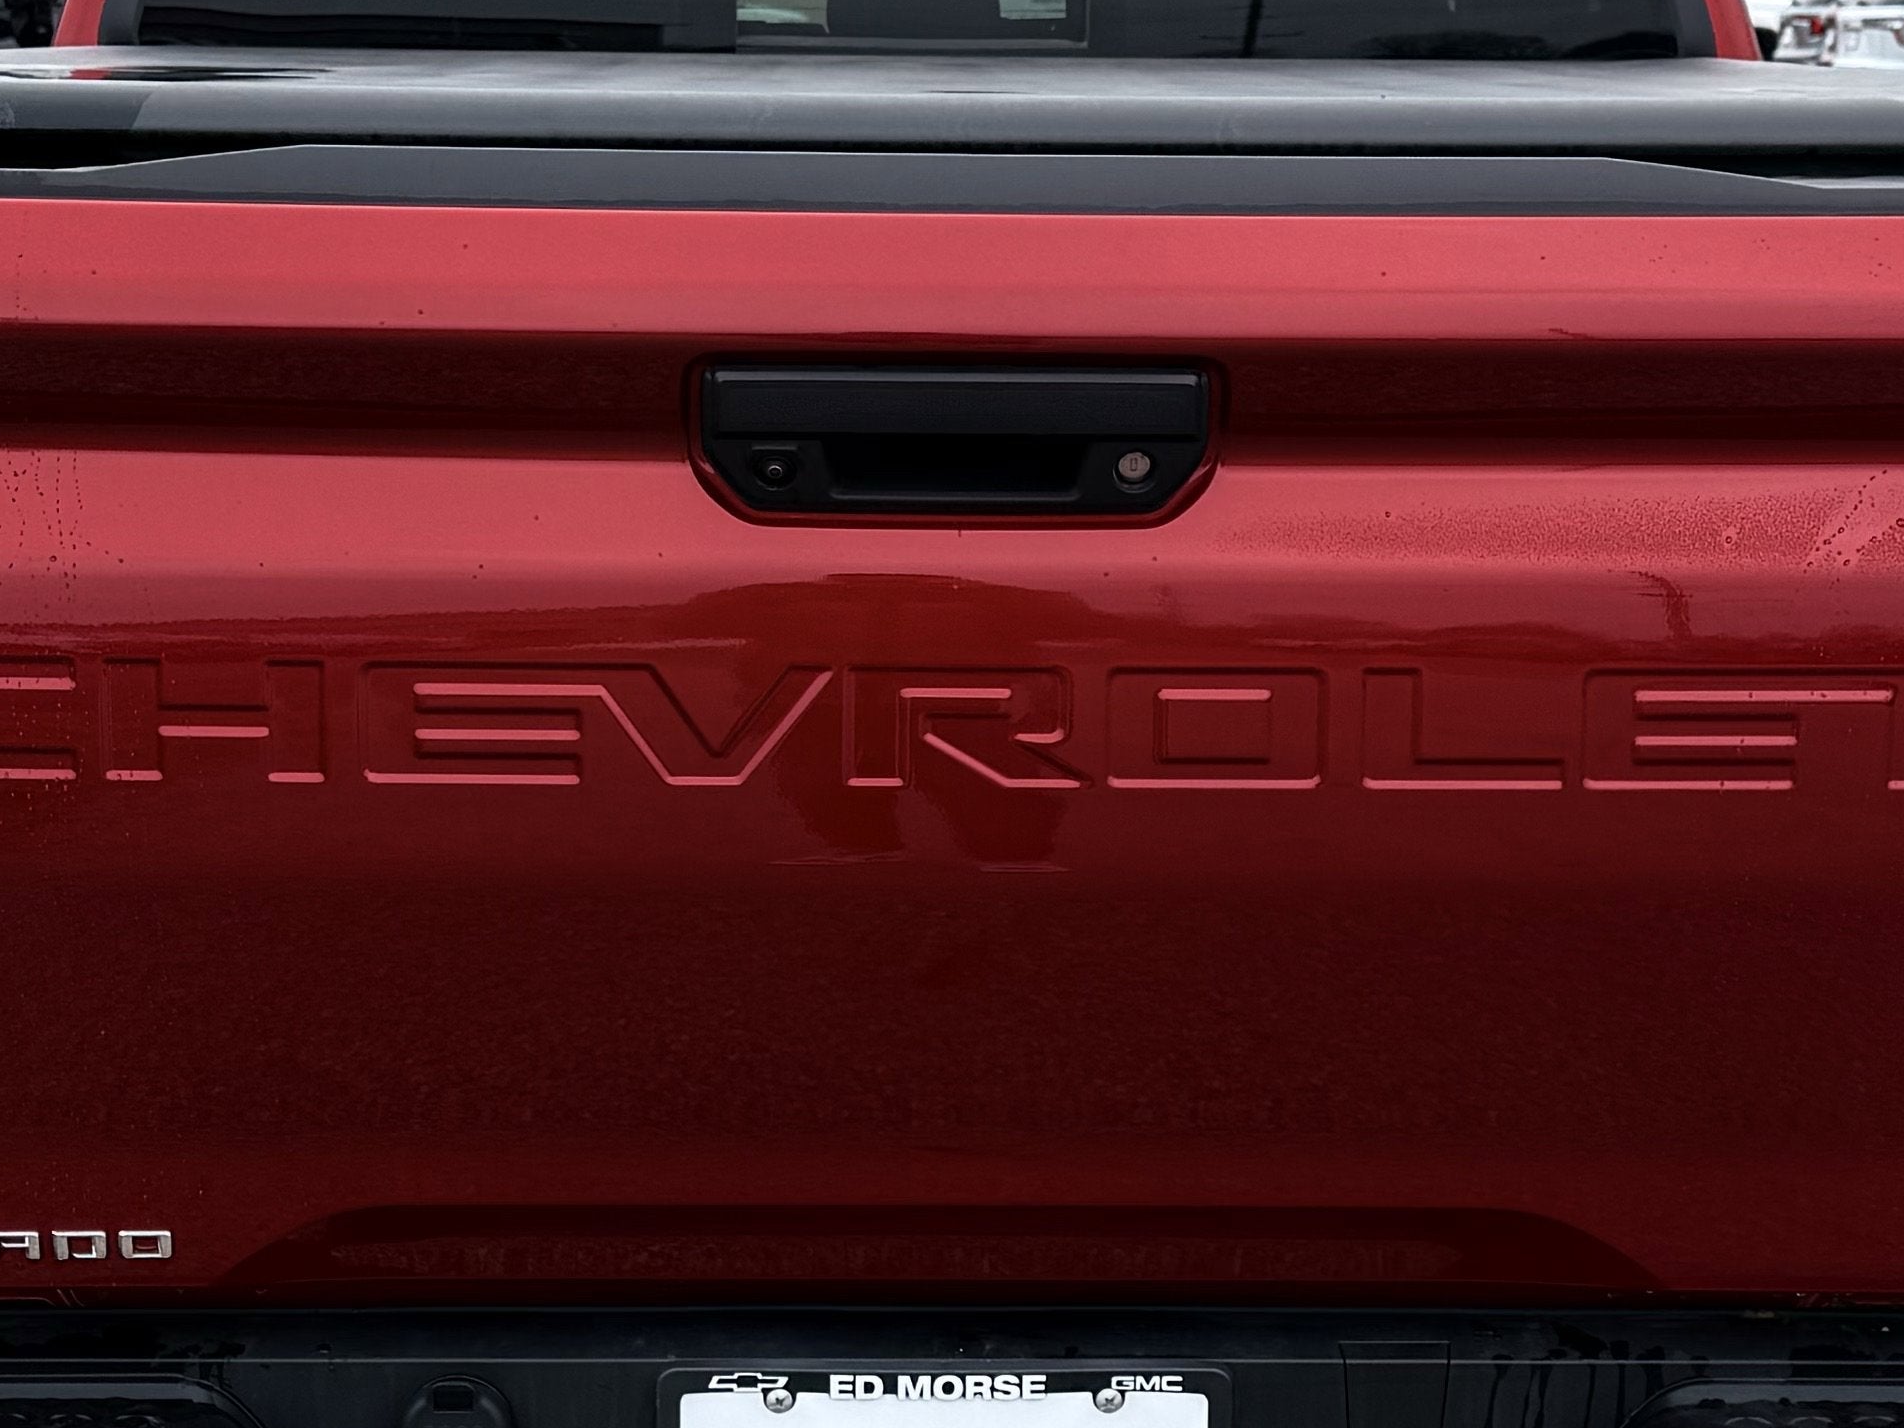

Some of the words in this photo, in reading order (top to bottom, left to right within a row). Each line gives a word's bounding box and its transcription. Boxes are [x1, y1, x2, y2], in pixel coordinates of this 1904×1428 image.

[829, 1374, 884, 1400] ED
[895, 1374, 1047, 1401] MORSE
[1110, 1375, 1184, 1392] GMC
